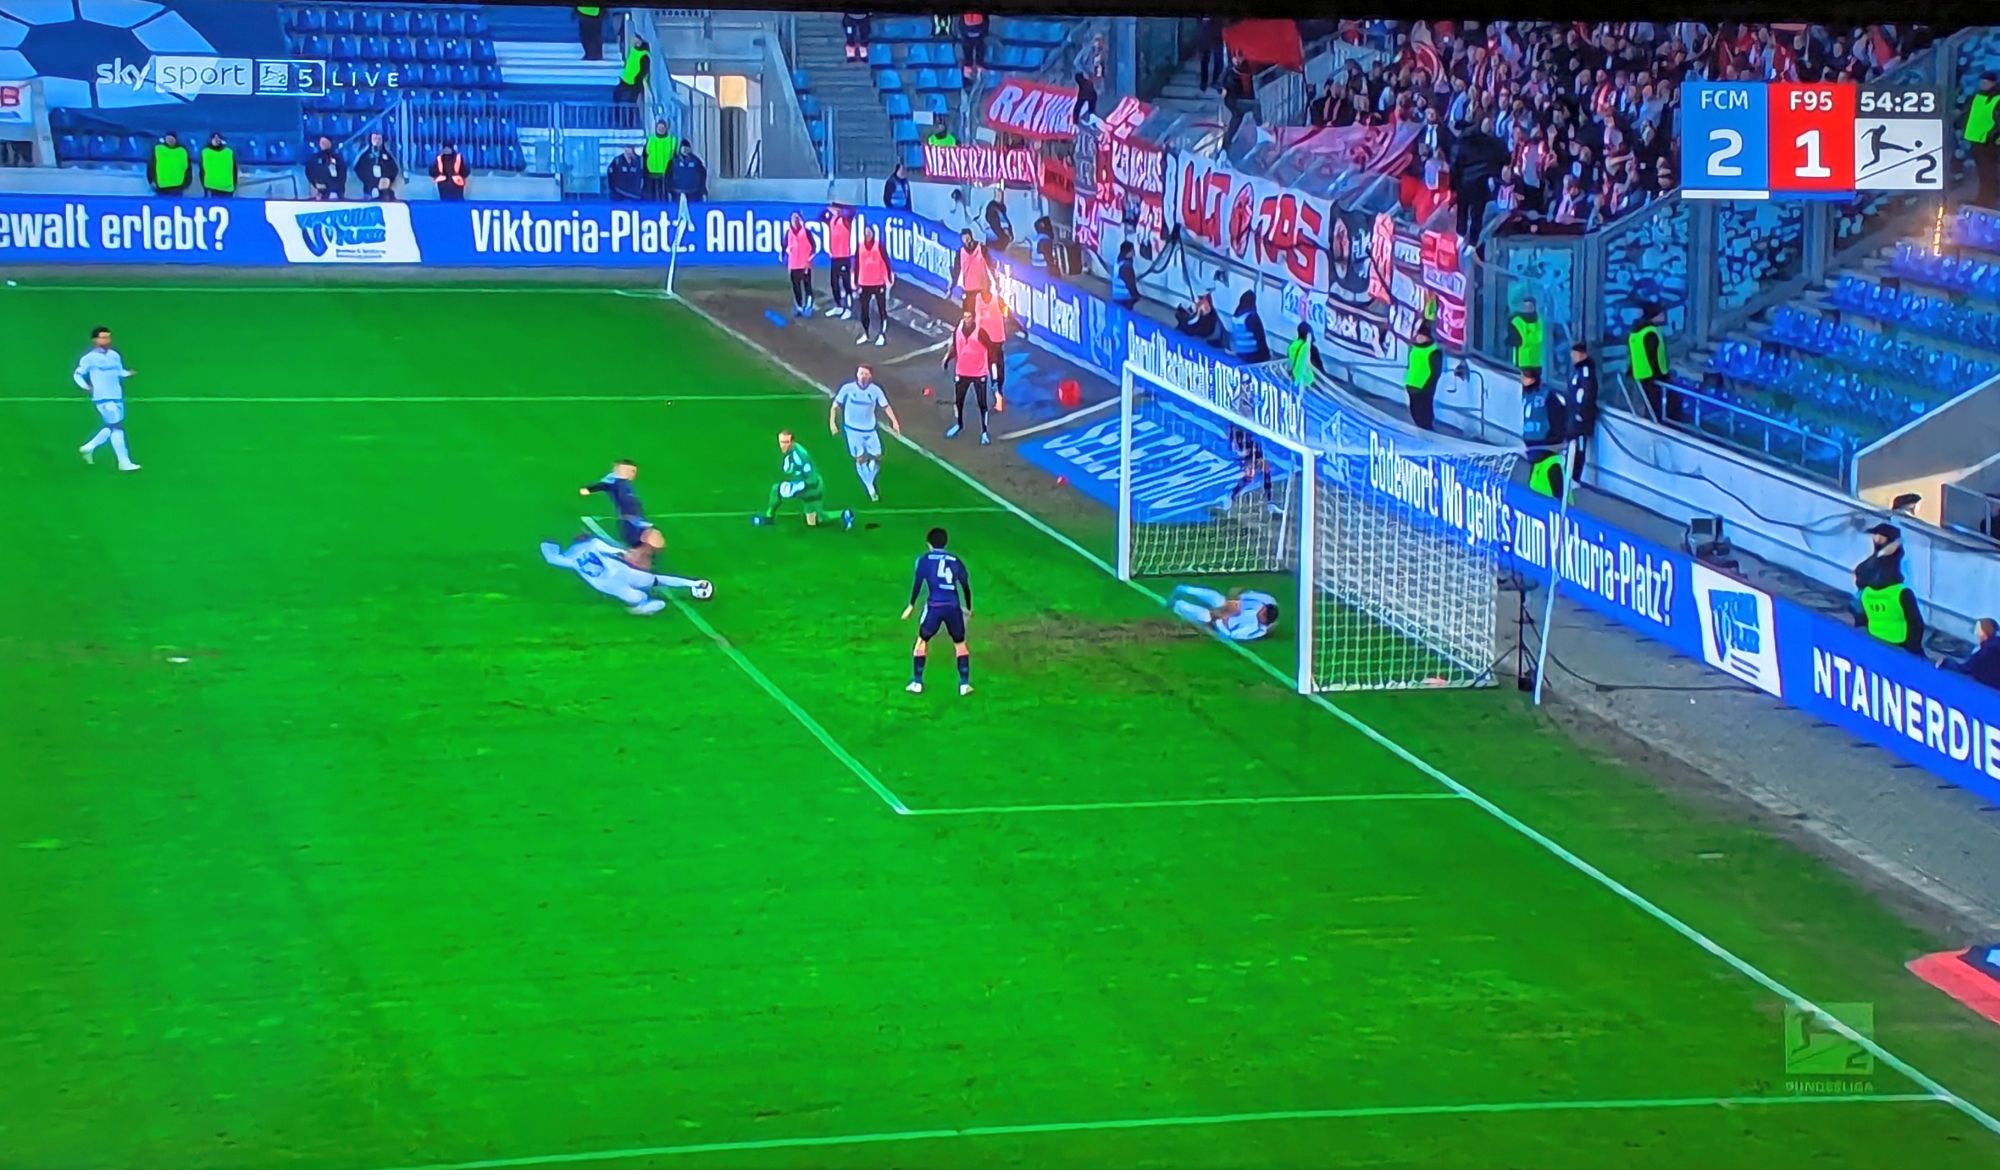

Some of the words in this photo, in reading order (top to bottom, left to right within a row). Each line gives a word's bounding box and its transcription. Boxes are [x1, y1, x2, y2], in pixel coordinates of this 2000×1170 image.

[96, 57, 151, 91] sky
[162, 60, 246, 88] sport
[299, 69, 313, 88] 5
[332, 70, 400, 87] LIVE
[1701, 90, 1749, 110] FCM
[1790, 91, 1833, 111] F95
[1860, 91, 1936, 112] 54:23
[1707, 129, 1743, 176] 2
[1795, 130, 1831, 178] 1
[102, 206, 229, 251] erlebt?
[471, 209, 695, 253] Viktoria-Platz:
[885, 216, 914, 262] für
[1369, 430, 1438, 517] Codewort:
[1440, 463, 1463, 529] Wo
[1466, 480, 1511, 553] geht's
[1513, 508, 1546, 568] zum
[1549, 511, 1674, 627] Viktoria-Platz?
[937, 558, 953, 584] 4
[1813, 646, 2000, 782] NTAINERDIE
